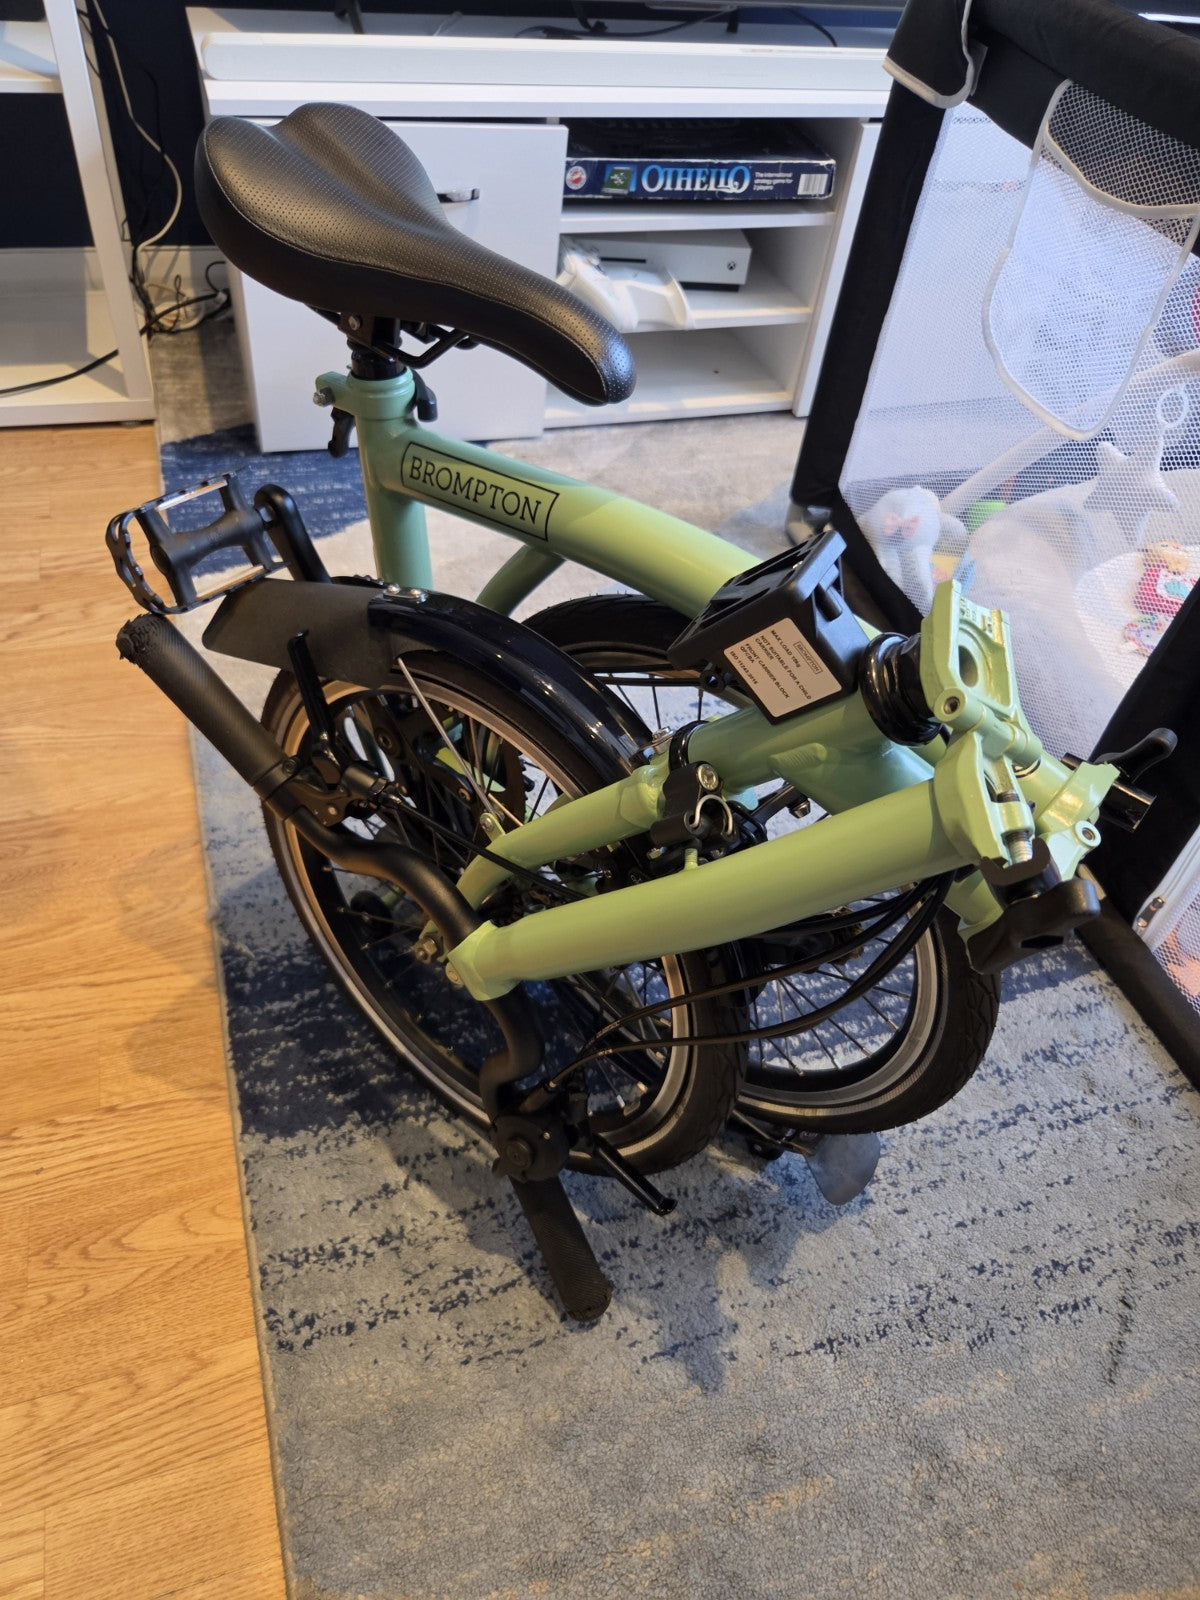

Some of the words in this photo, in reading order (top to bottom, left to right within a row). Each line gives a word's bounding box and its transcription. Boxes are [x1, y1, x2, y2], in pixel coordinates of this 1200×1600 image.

[642, 165, 750, 193] OTHELLO
[409, 456, 541, 524] BROMPTON
[730, 651, 739, 660] ISO
[755, 638, 774, 660] CARRIER
[771, 630, 781, 641] MAX
[780, 640, 792, 655] LOAD
[745, 643, 760, 660] FRONT
[758, 660, 777, 682] CARRIER
[774, 681, 790, 699] BLOCK
[760, 635, 771, 646] NOT
[769, 646, 790, 670] SUITABLE
[787, 669, 797, 681] FOR
[798, 684, 812, 700] CHILD
[797, 644, 820, 672] BROMPTON
